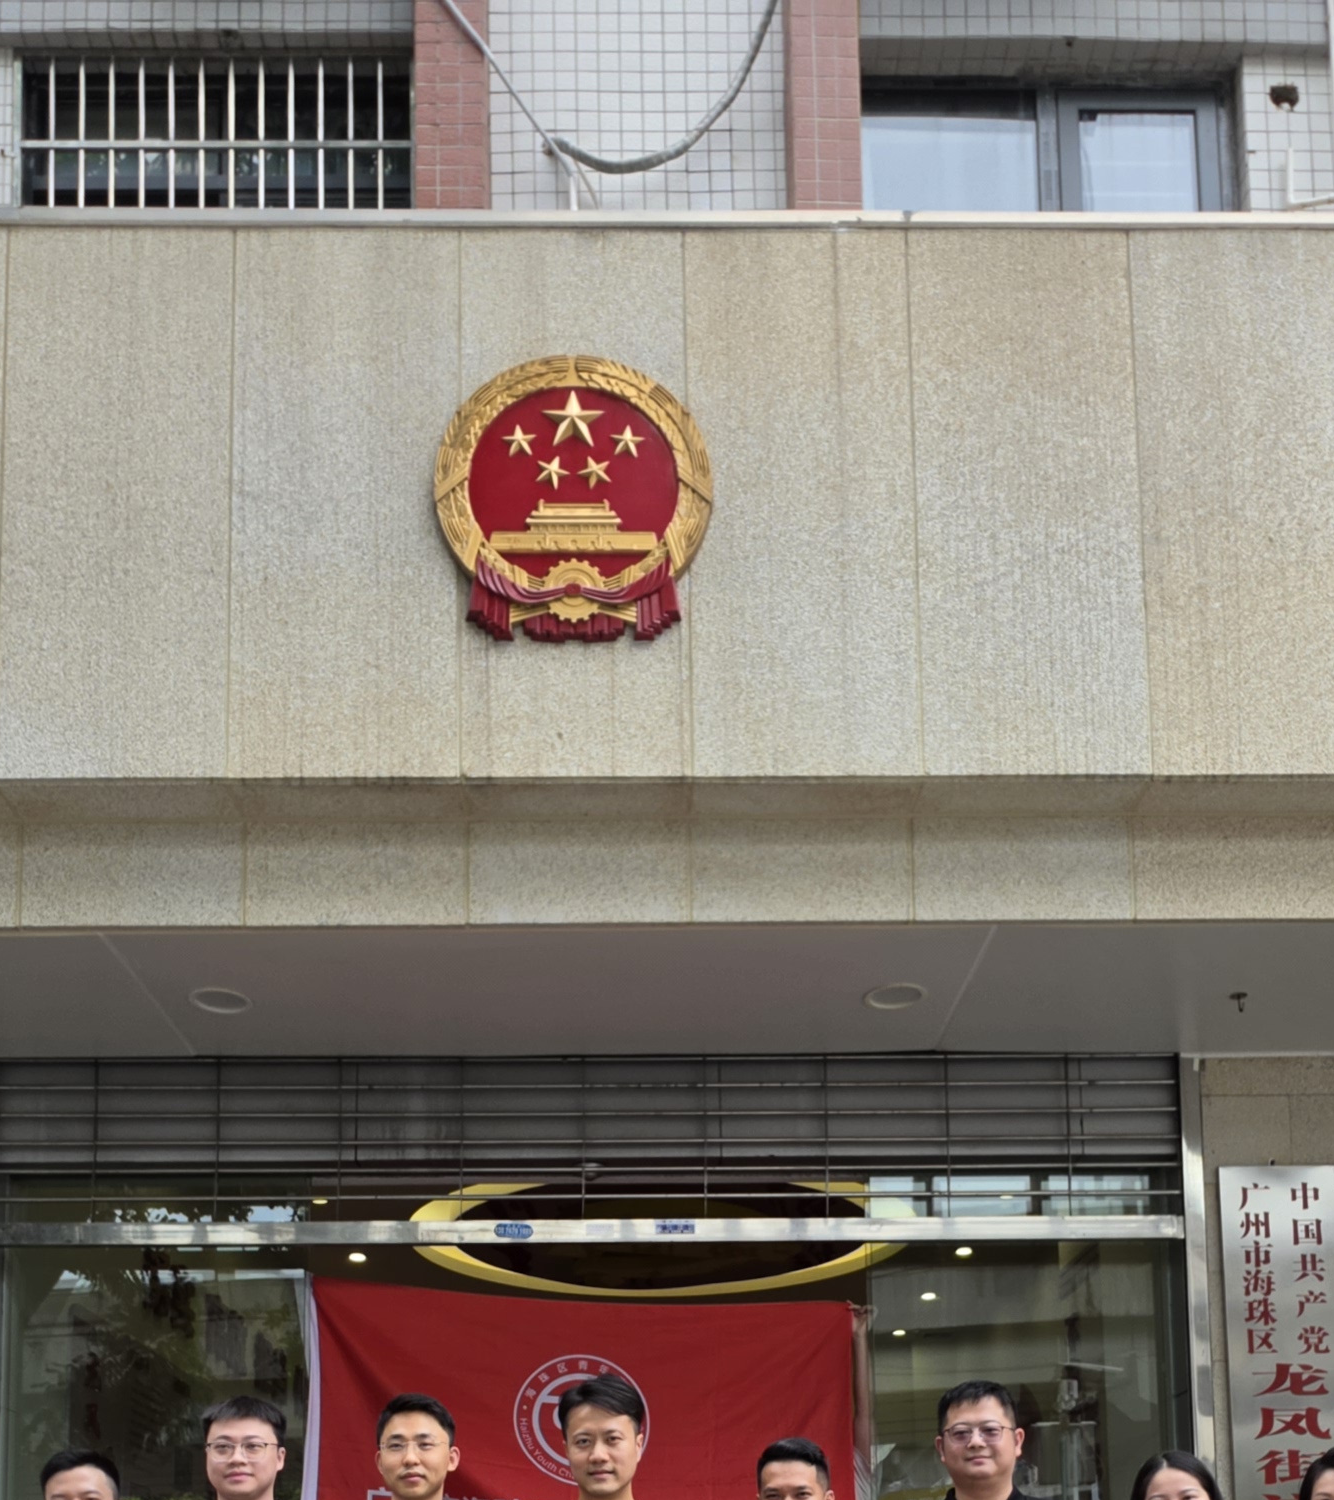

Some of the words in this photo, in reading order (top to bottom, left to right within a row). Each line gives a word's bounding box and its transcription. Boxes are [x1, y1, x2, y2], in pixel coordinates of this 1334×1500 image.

[1238, 1182, 1279, 1354] 广州市海珠区
[1290, 1181, 1331, 1355] 中国共产党
[519, 1417, 534, 1450] Haizhu
[533, 1449, 557, 1473] Youth
